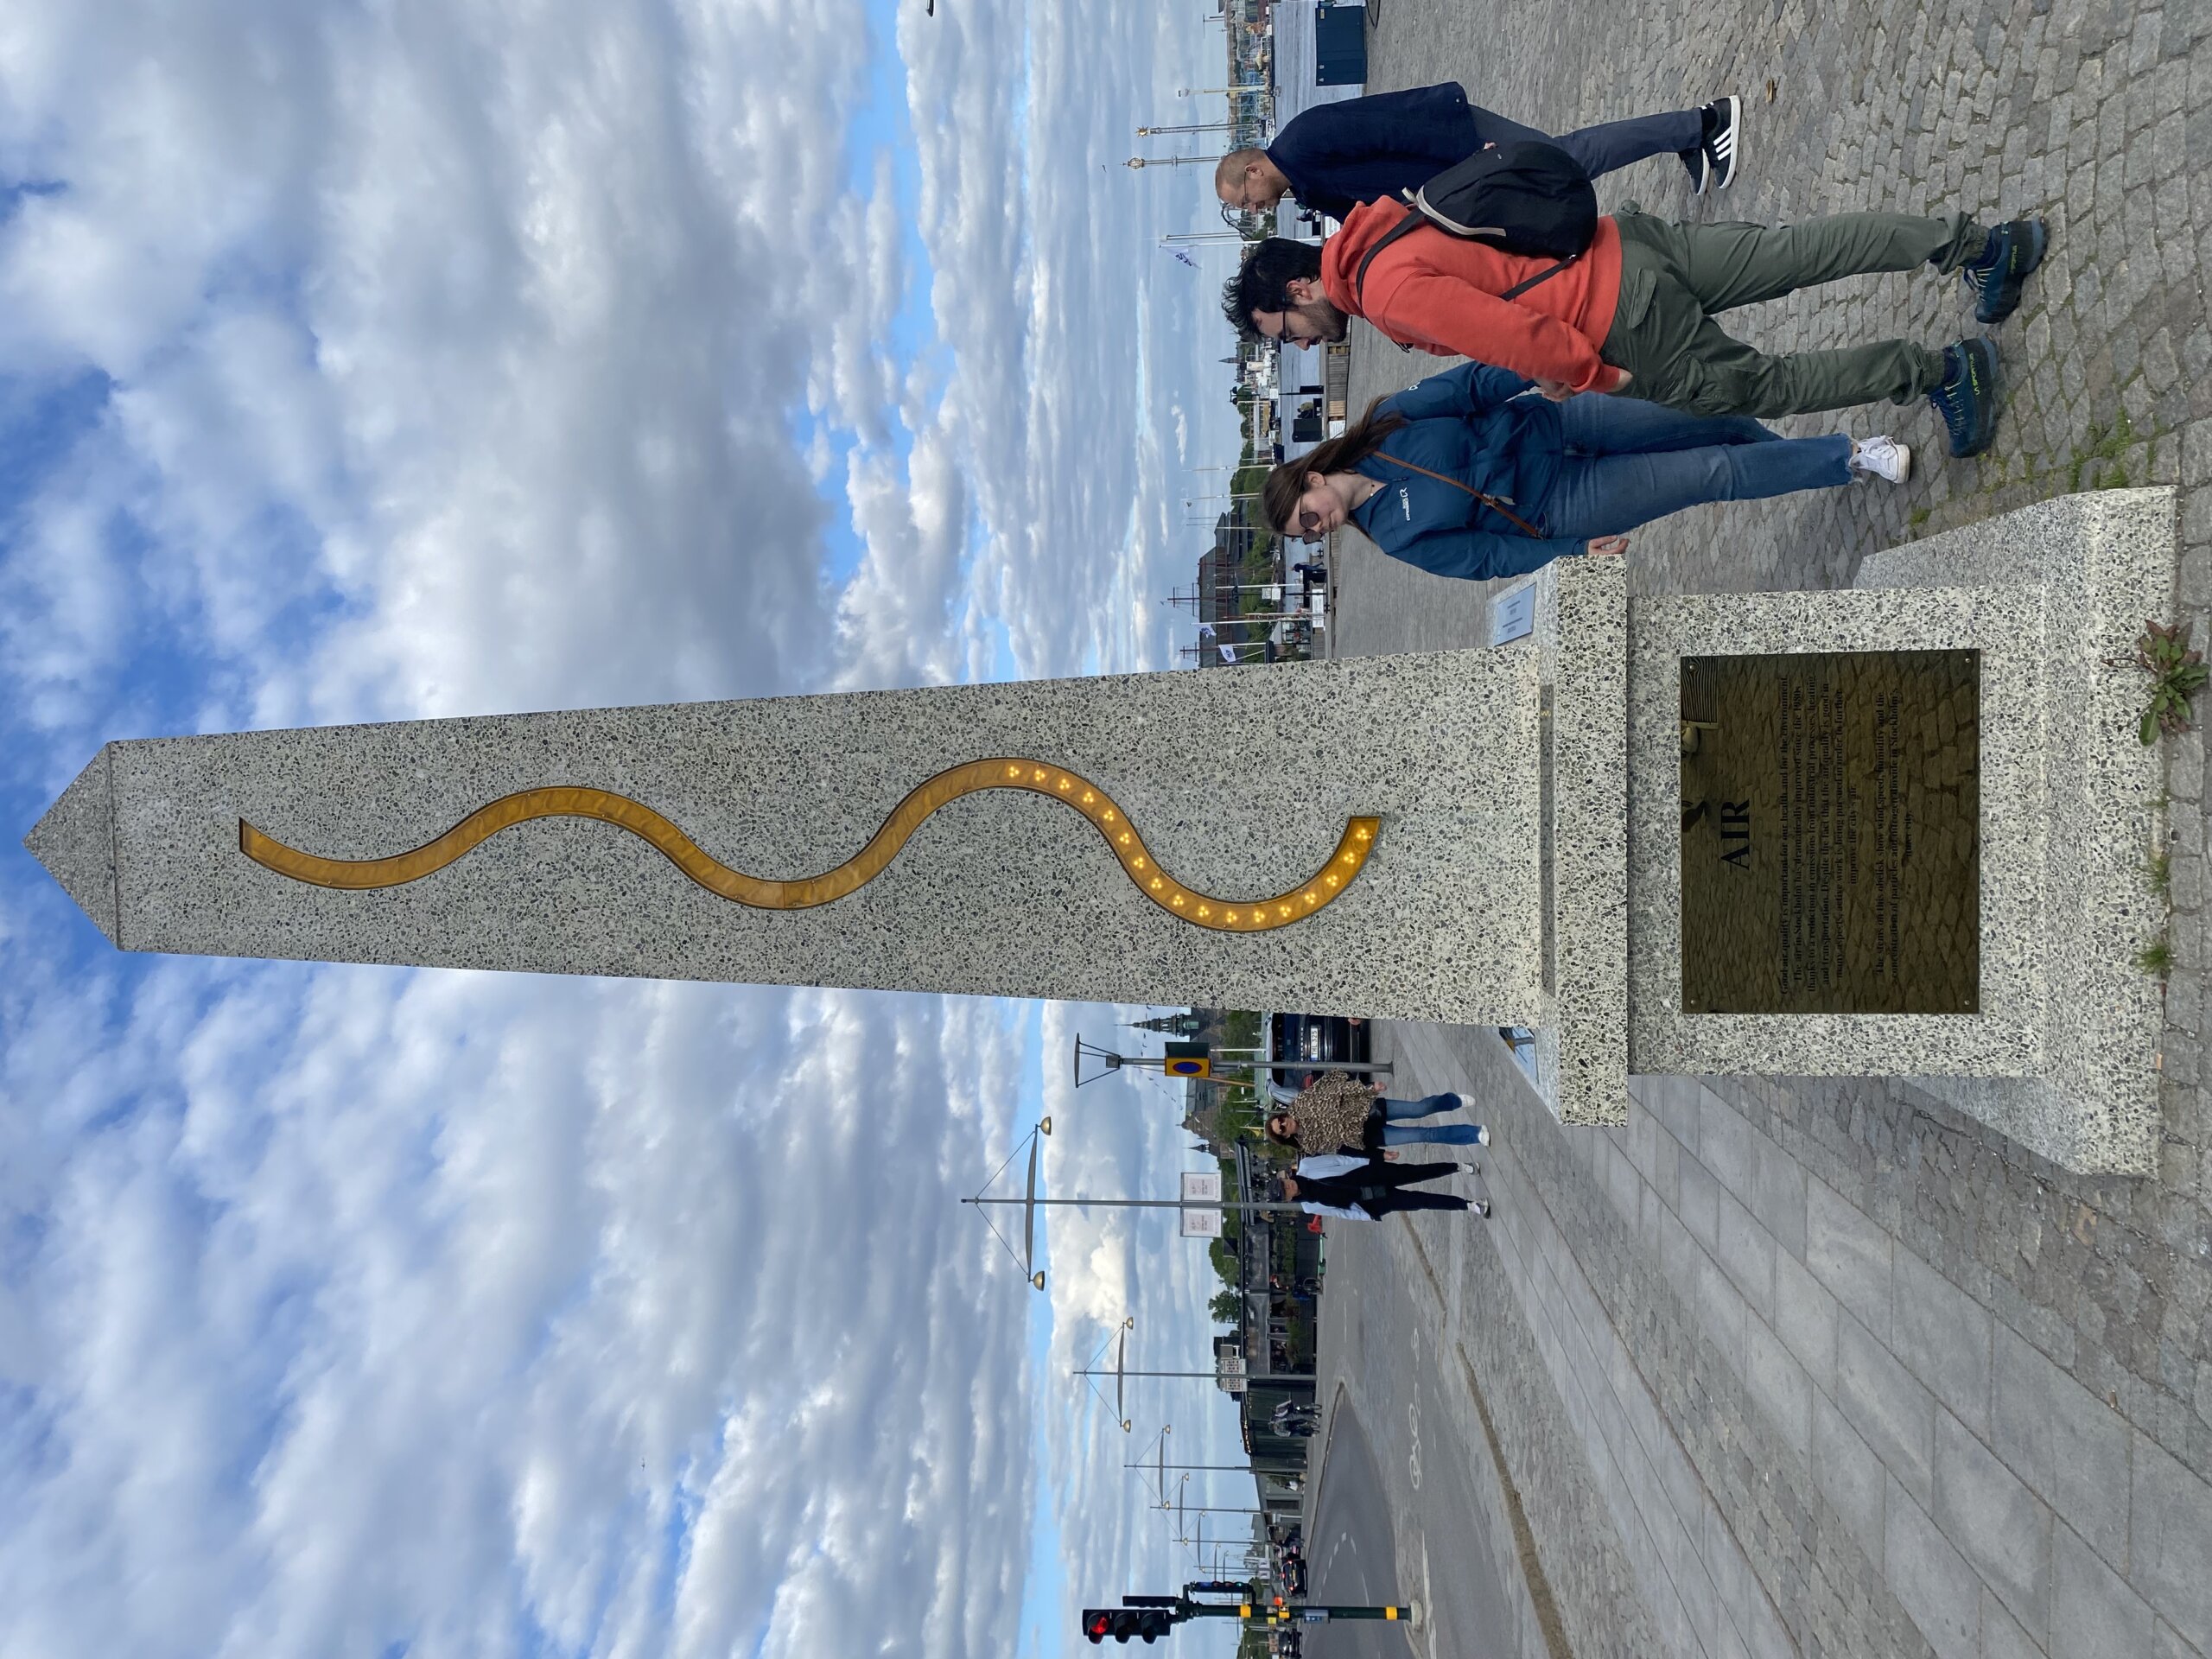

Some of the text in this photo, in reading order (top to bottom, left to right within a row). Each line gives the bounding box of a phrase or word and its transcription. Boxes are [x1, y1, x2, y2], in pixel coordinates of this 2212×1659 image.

[1974, 386, 1980, 395] LA
[1808, 677, 1818, 710] heating
[1821, 683, 1829, 692] in
[1876, 692, 1885, 707] the
[1821, 696, 1831, 717] good
[1834, 690, 1843, 724] further
[1876, 709, 1885, 727] and
[1834, 726, 1843, 735] to
[1821, 731, 1831, 763] quality
[1834, 738, 1843, 765] order
[1876, 731, 1886, 772] humidity
[1794, 759, 1804, 803] improved
[1834, 766, 1843, 776] in
[1834, 779, 1845, 817] pursued
[1876, 807, 1885, 829] wind
[1720, 799, 1749, 870] AIR
[1794, 806, 1804, 864] dramatically
[1834, 819, 1845, 845] being
[1848, 829, 1857, 843] the
[1876, 833, 1885, 856] show
[1890, 688, 1900, 978] concentration of particles and nitrogen dioxide in Stockholm's
[1821, 858, 1831, 892] Despite
[1834, 858, 1843, 881] work
[1848, 846, 1859, 885] improve
[1876, 860, 1885, 892] obelisk
[1780, 860, 1790, 906] important
[1808, 882, 1815, 892] in
[1834, 885, 1843, 912] active
[1876, 893, 1885, 911] this
[1878, 913, 1885, 925] on
[1780, 919, 1790, 950] quality
[1794, 937, 1802, 946] in
[1876, 929, 1885, 954] stems
[1808, 949, 1815, 958] to
[1876, 957, 1885, 975] The
